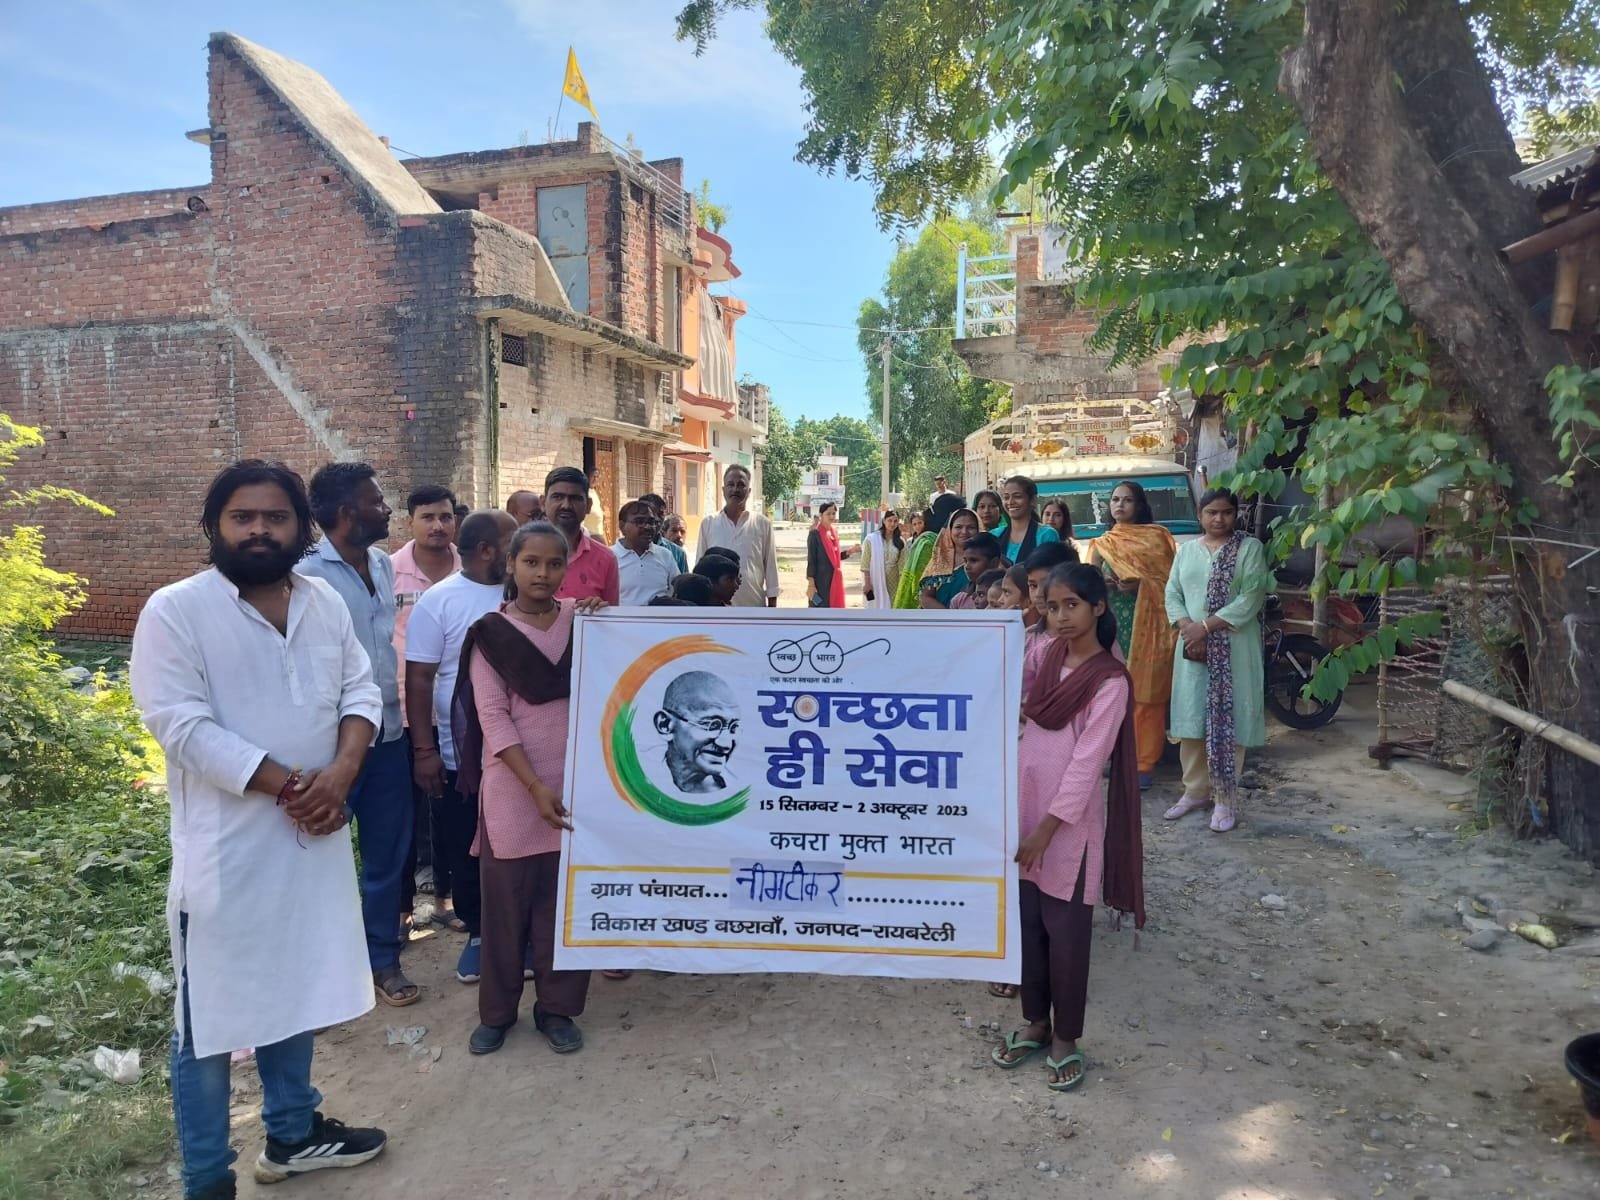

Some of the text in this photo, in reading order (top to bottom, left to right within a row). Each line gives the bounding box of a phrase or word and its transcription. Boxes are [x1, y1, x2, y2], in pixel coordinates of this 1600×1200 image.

[776, 653, 836, 662] स्वच्छ भारत
[769, 676, 780, 684] एक
[757, 690, 973, 731] स्वच्छता
[764, 730, 963, 789] ही सेवा
[759, 799, 774, 811] 15
[778, 795, 839, 812] सितम्बर
[856, 802, 866, 813] 2
[870, 802, 928, 820] अक्टूबर
[936, 804, 968, 816] 2023
[769, 831, 956, 860] कचरा मुक्त भारत
[590, 882, 634, 899] ग्राम
[590, 912, 658, 931] विकास
[662, 918, 710, 934] खण्ड
[714, 915, 788, 936] बछरावाँ,
